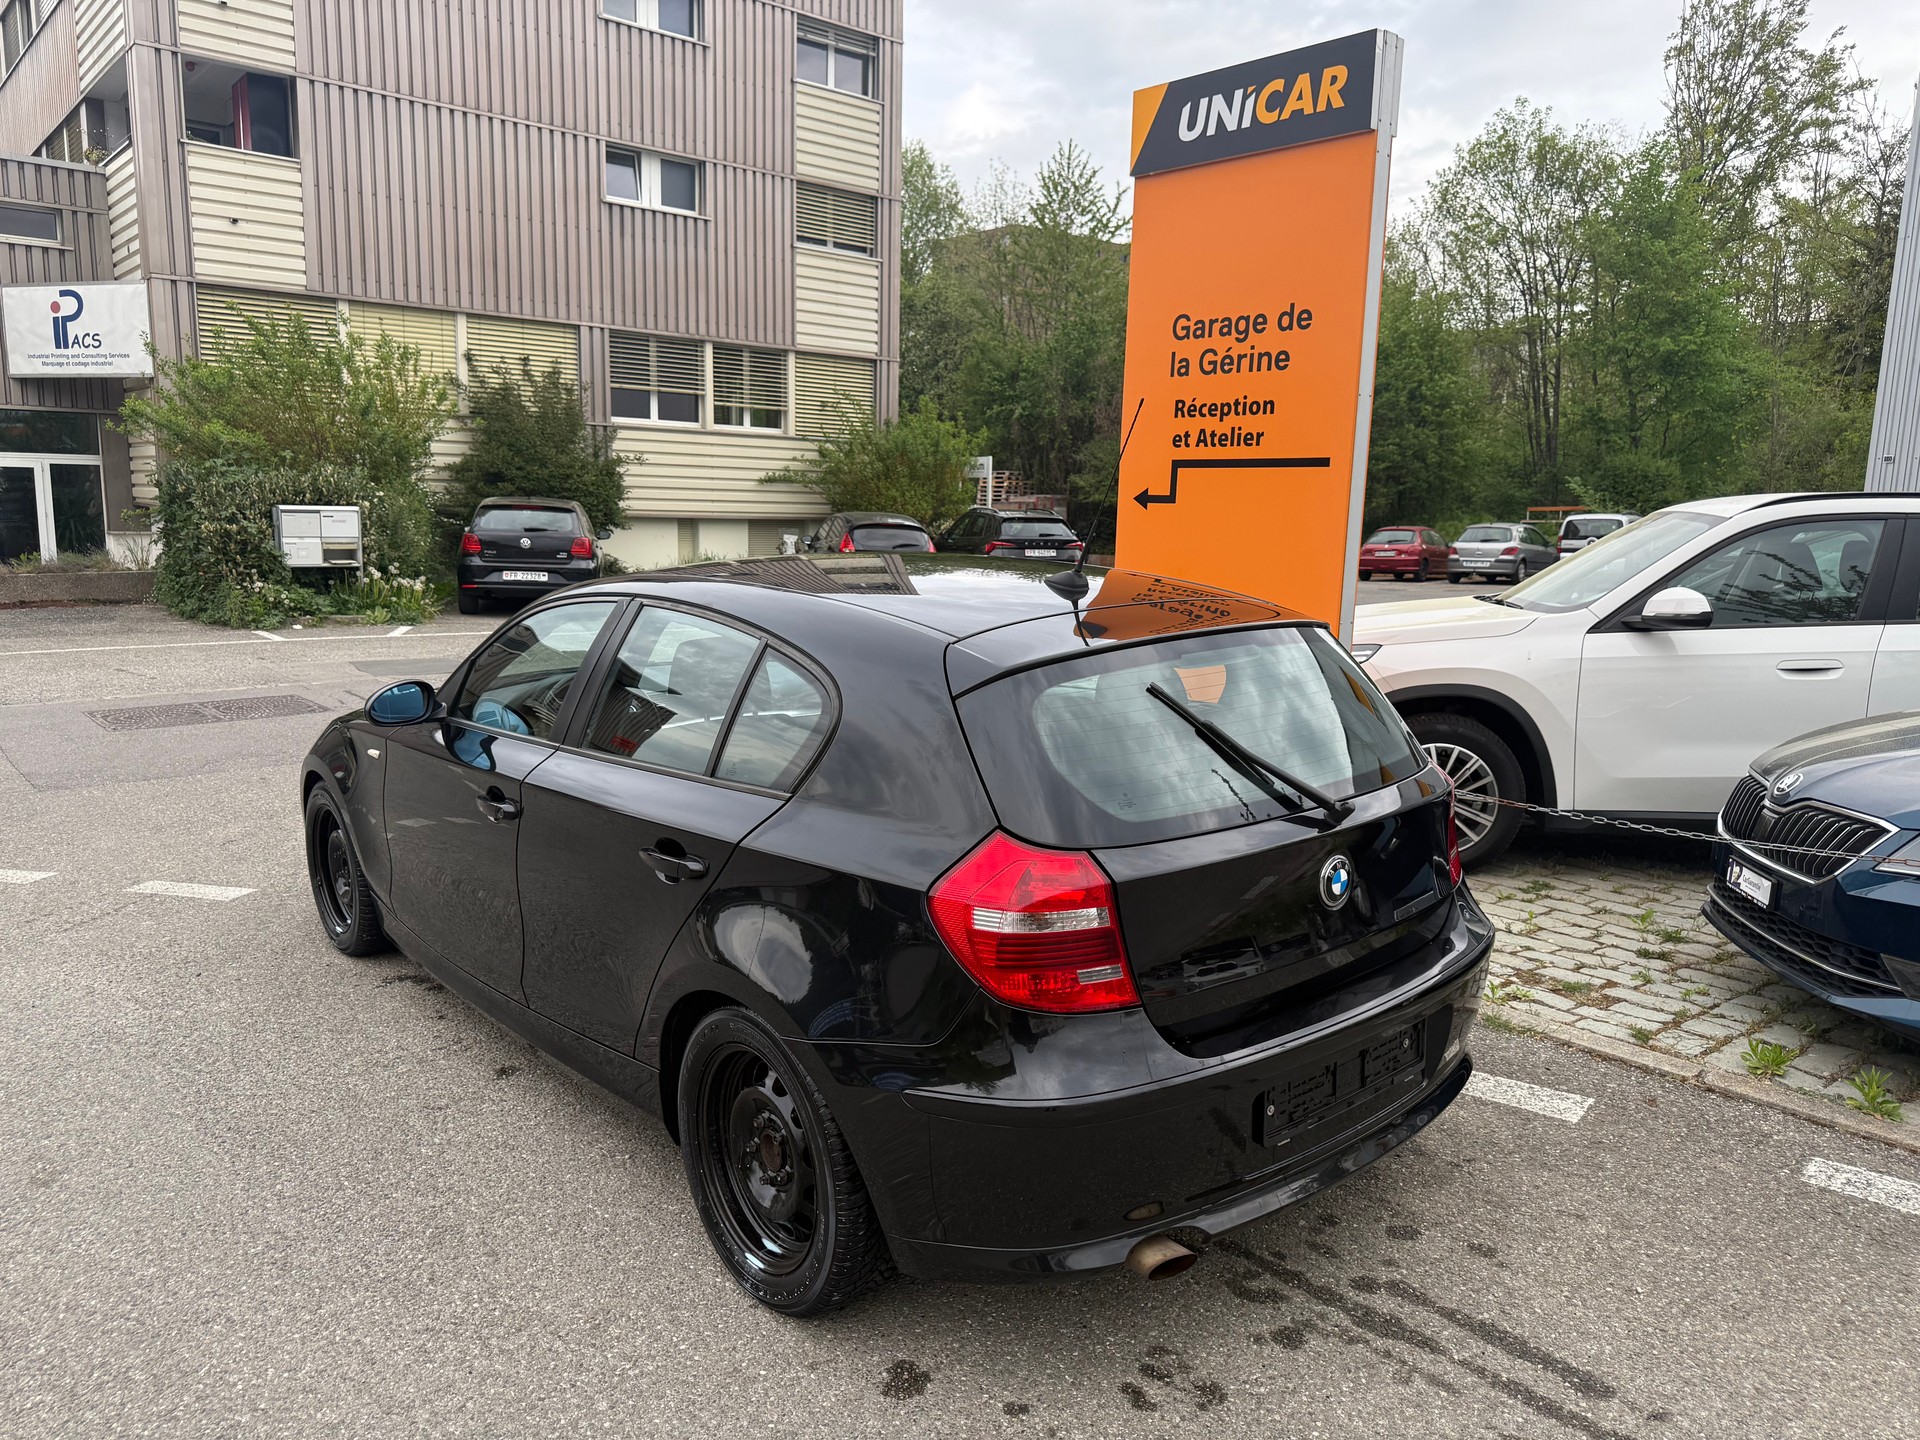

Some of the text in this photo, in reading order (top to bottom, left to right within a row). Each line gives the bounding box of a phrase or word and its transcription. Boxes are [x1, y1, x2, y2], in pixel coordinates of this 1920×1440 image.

[1172, 303, 1313, 343] Garage de
[51, 352, 69, 360] Printing
[81, 352, 108, 360] Consulting
[1170, 345, 1291, 377] la Gérine
[1174, 395, 1275, 422] Réception
[1172, 426, 1264, 448] et Atelier
